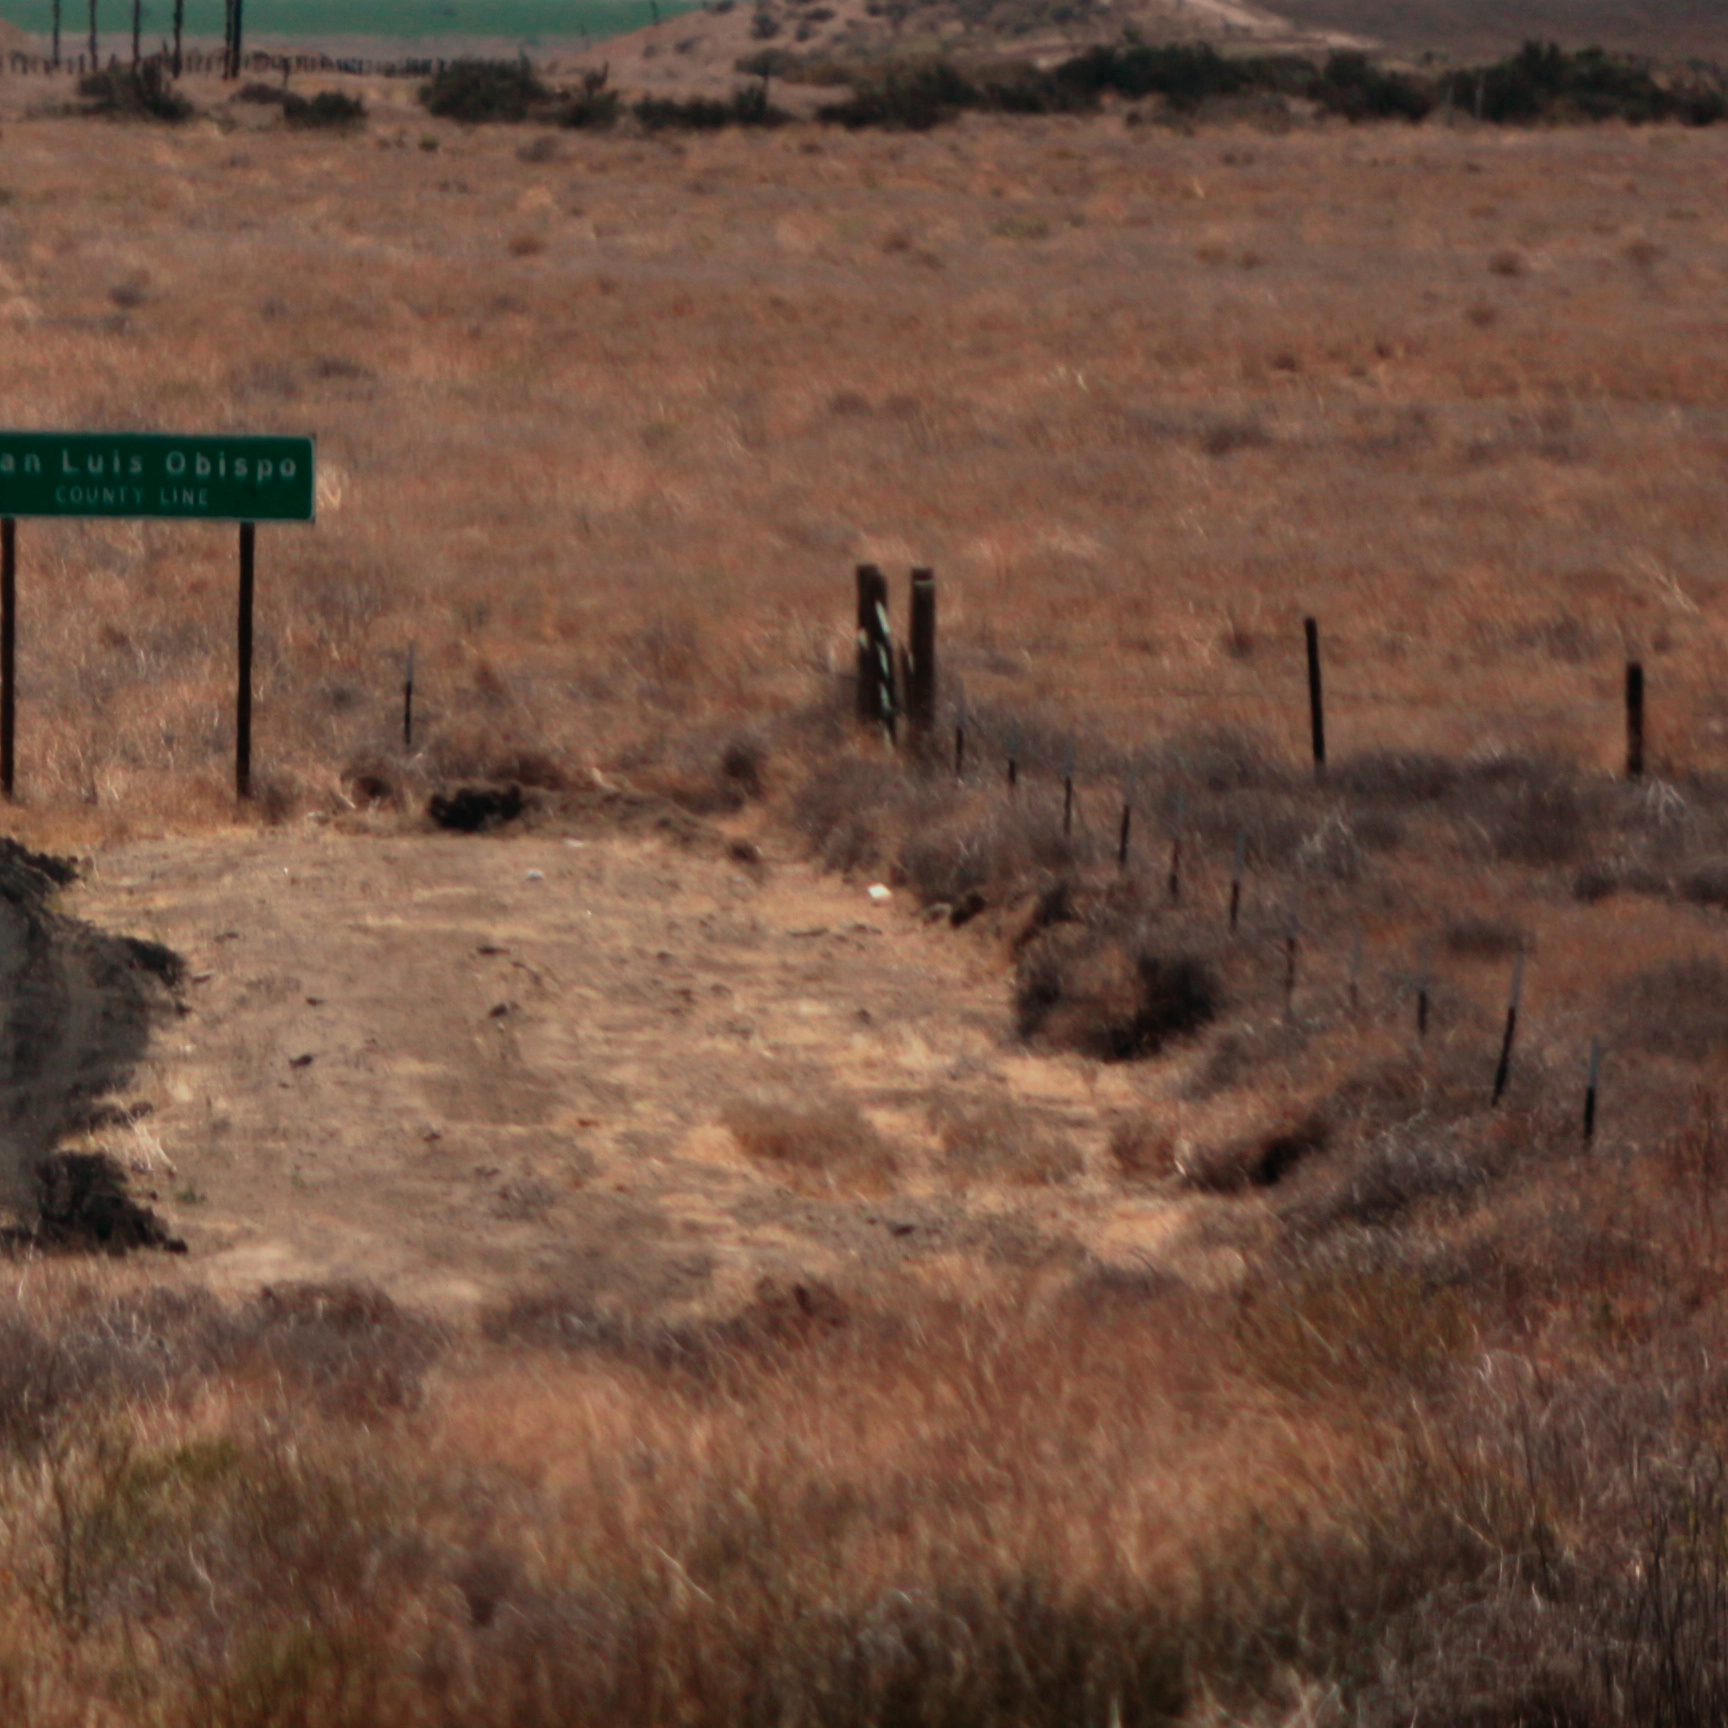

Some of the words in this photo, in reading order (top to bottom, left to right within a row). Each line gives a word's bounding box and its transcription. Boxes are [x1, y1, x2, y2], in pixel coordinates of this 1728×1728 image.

[62, 448, 143, 474] Luis
[165, 450, 297, 482] Obispo
[55, 485, 144, 505] COUNTY
[160, 486, 209, 508] LINE
